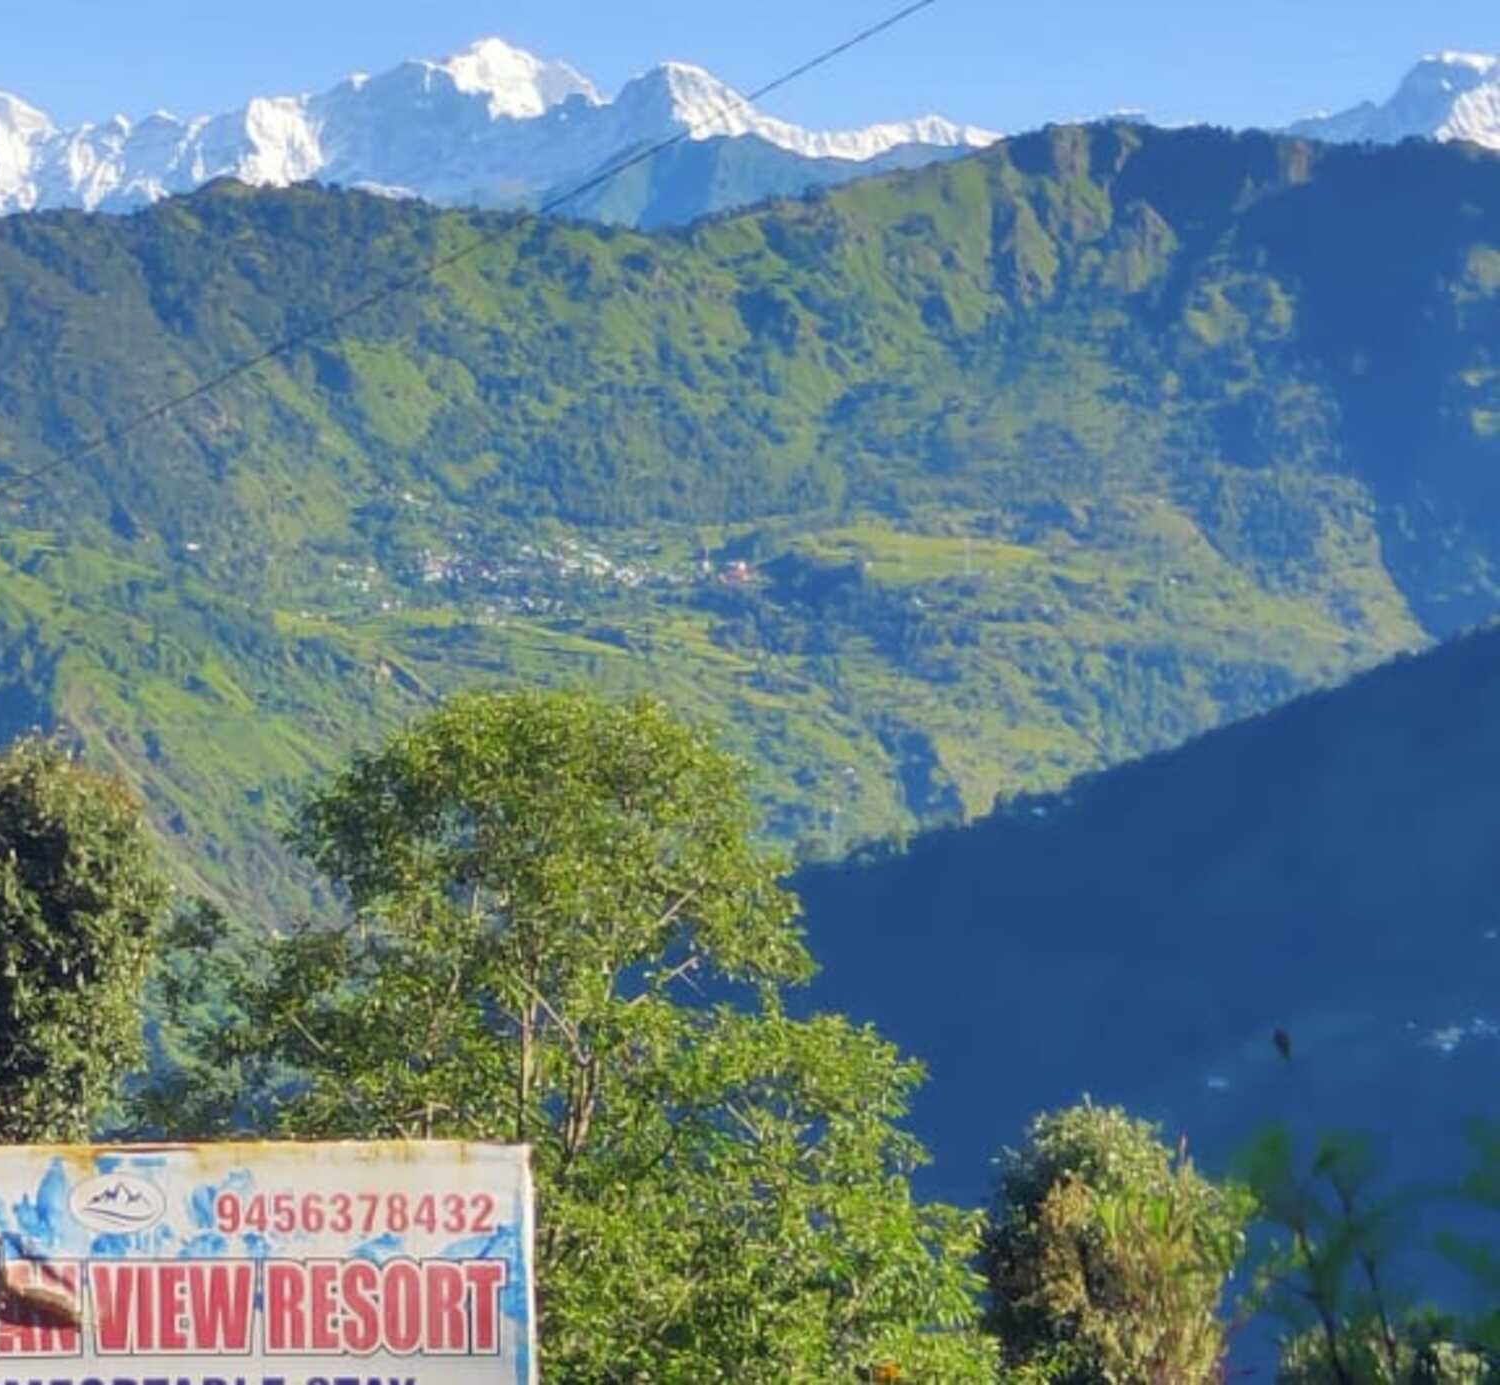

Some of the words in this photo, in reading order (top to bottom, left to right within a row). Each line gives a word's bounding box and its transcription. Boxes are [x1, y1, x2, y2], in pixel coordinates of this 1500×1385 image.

[216, 1194, 496, 1234] 9456378432
[93, 1264, 251, 1352] VIEW
[266, 1260, 504, 1352] RESORT
